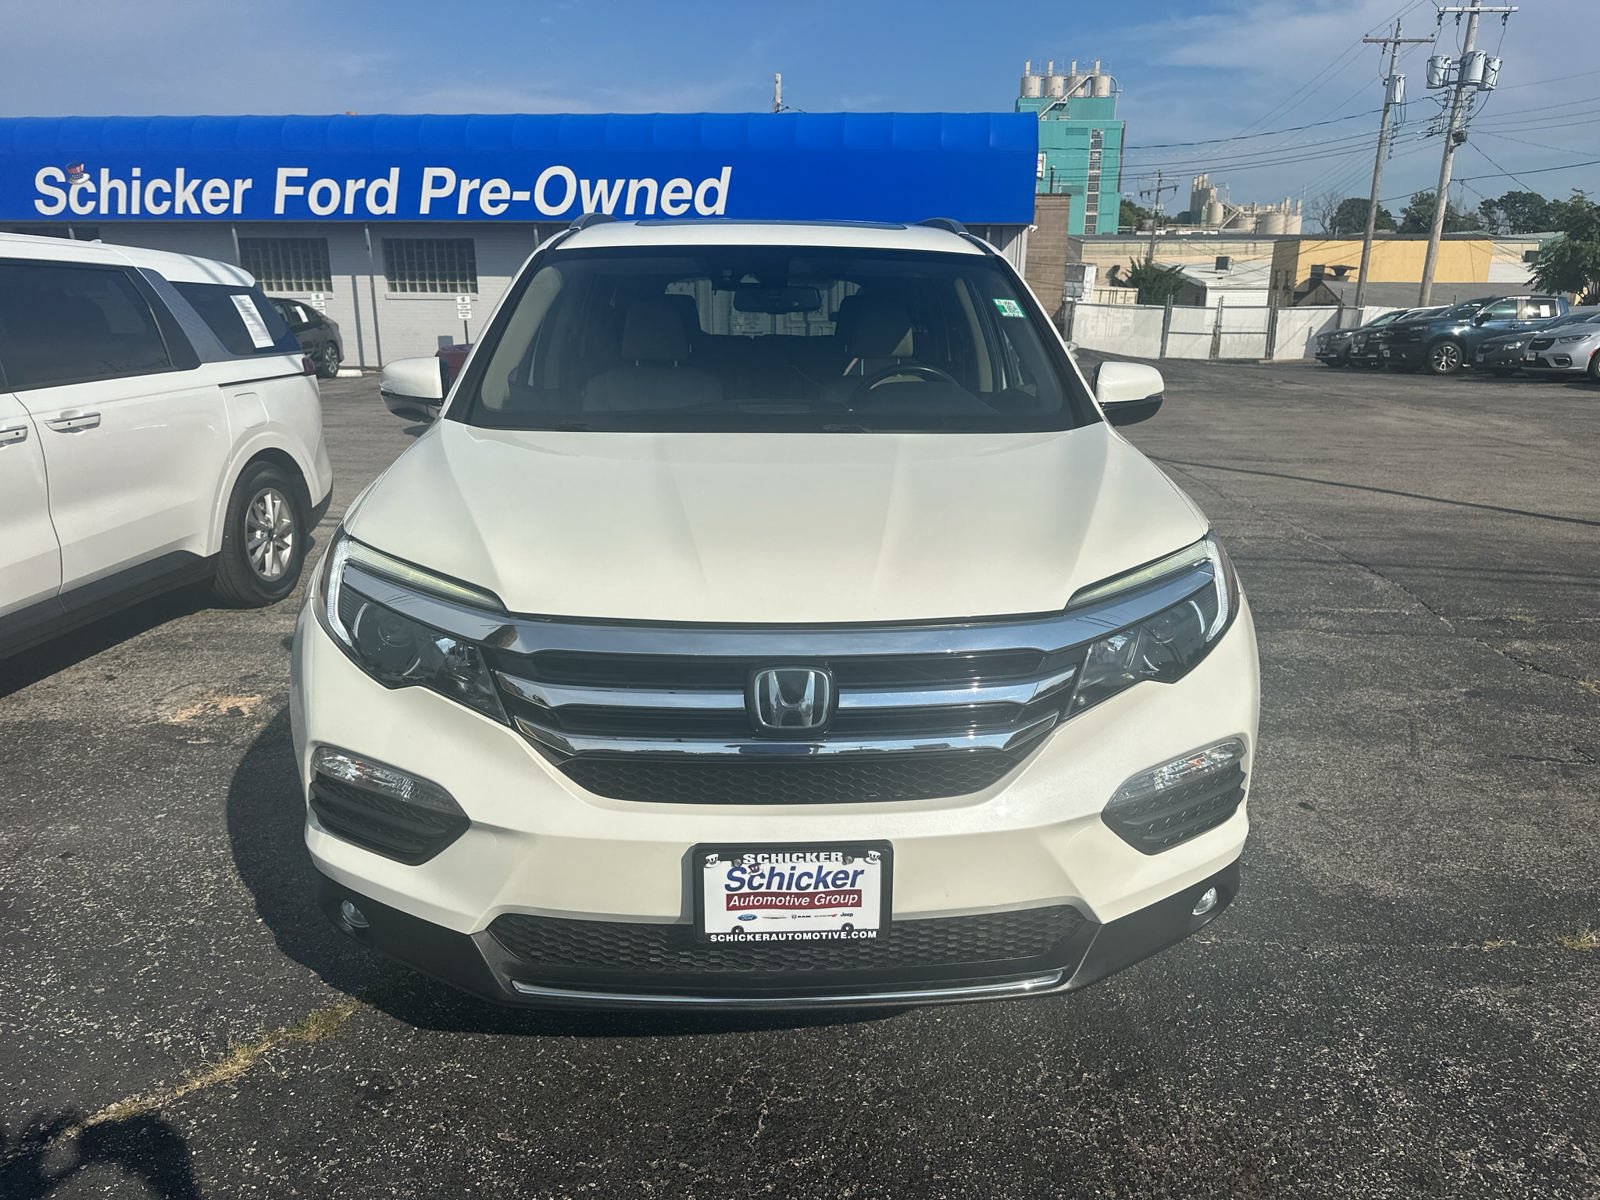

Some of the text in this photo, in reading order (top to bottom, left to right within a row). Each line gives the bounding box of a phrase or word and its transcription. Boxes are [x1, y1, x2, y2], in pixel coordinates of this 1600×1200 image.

[34, 165, 732, 216] Schicker Ford Pre-Owned
[742, 852, 844, 865] SCHICKER
[724, 865, 865, 893] Schicker
[729, 893, 858, 908] Automotive Group
[710, 931, 877, 942] SCHICKERAUTOMOTIVE.COM
